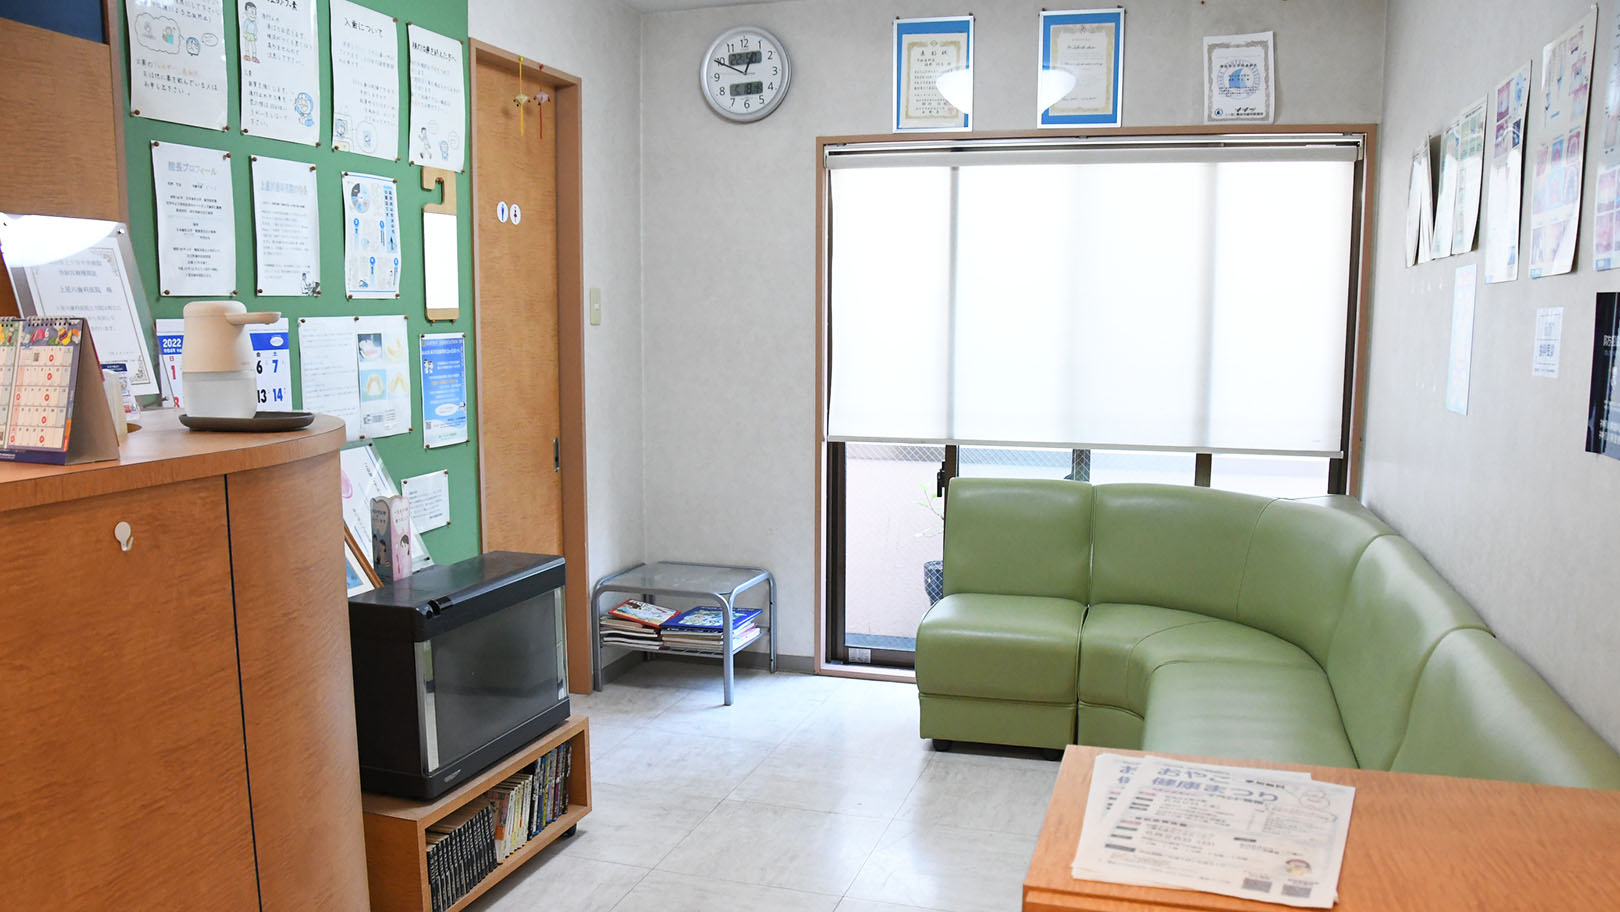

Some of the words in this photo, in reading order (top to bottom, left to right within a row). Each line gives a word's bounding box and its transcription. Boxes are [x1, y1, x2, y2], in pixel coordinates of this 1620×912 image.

[727, 43, 735, 53] 11
[740, 39, 749, 48] 12
[767, 51, 773, 60] 2
[716, 57, 726, 66] 10
[772, 66, 778, 76] 3
[714, 73, 720, 82] 9
[719, 87, 725, 96] 8
[768, 82, 774, 91] 4
[730, 98, 736, 107] 7
[744, 99, 750, 109] 6
[759, 95, 765, 104] 5
[168, 161, 217, 176] 院長プロフィール
[162, 338, 182, 348] 2022
[256, 360, 263, 374] 6
[272, 359, 279, 373] 7
[171, 365, 177, 380] 1
[257, 389, 267, 403] 13
[272, 388, 283, 402] 14
[1157, 767, 1231, 785] おやこ
[1152, 776, 1279, 802] 健康まつり
